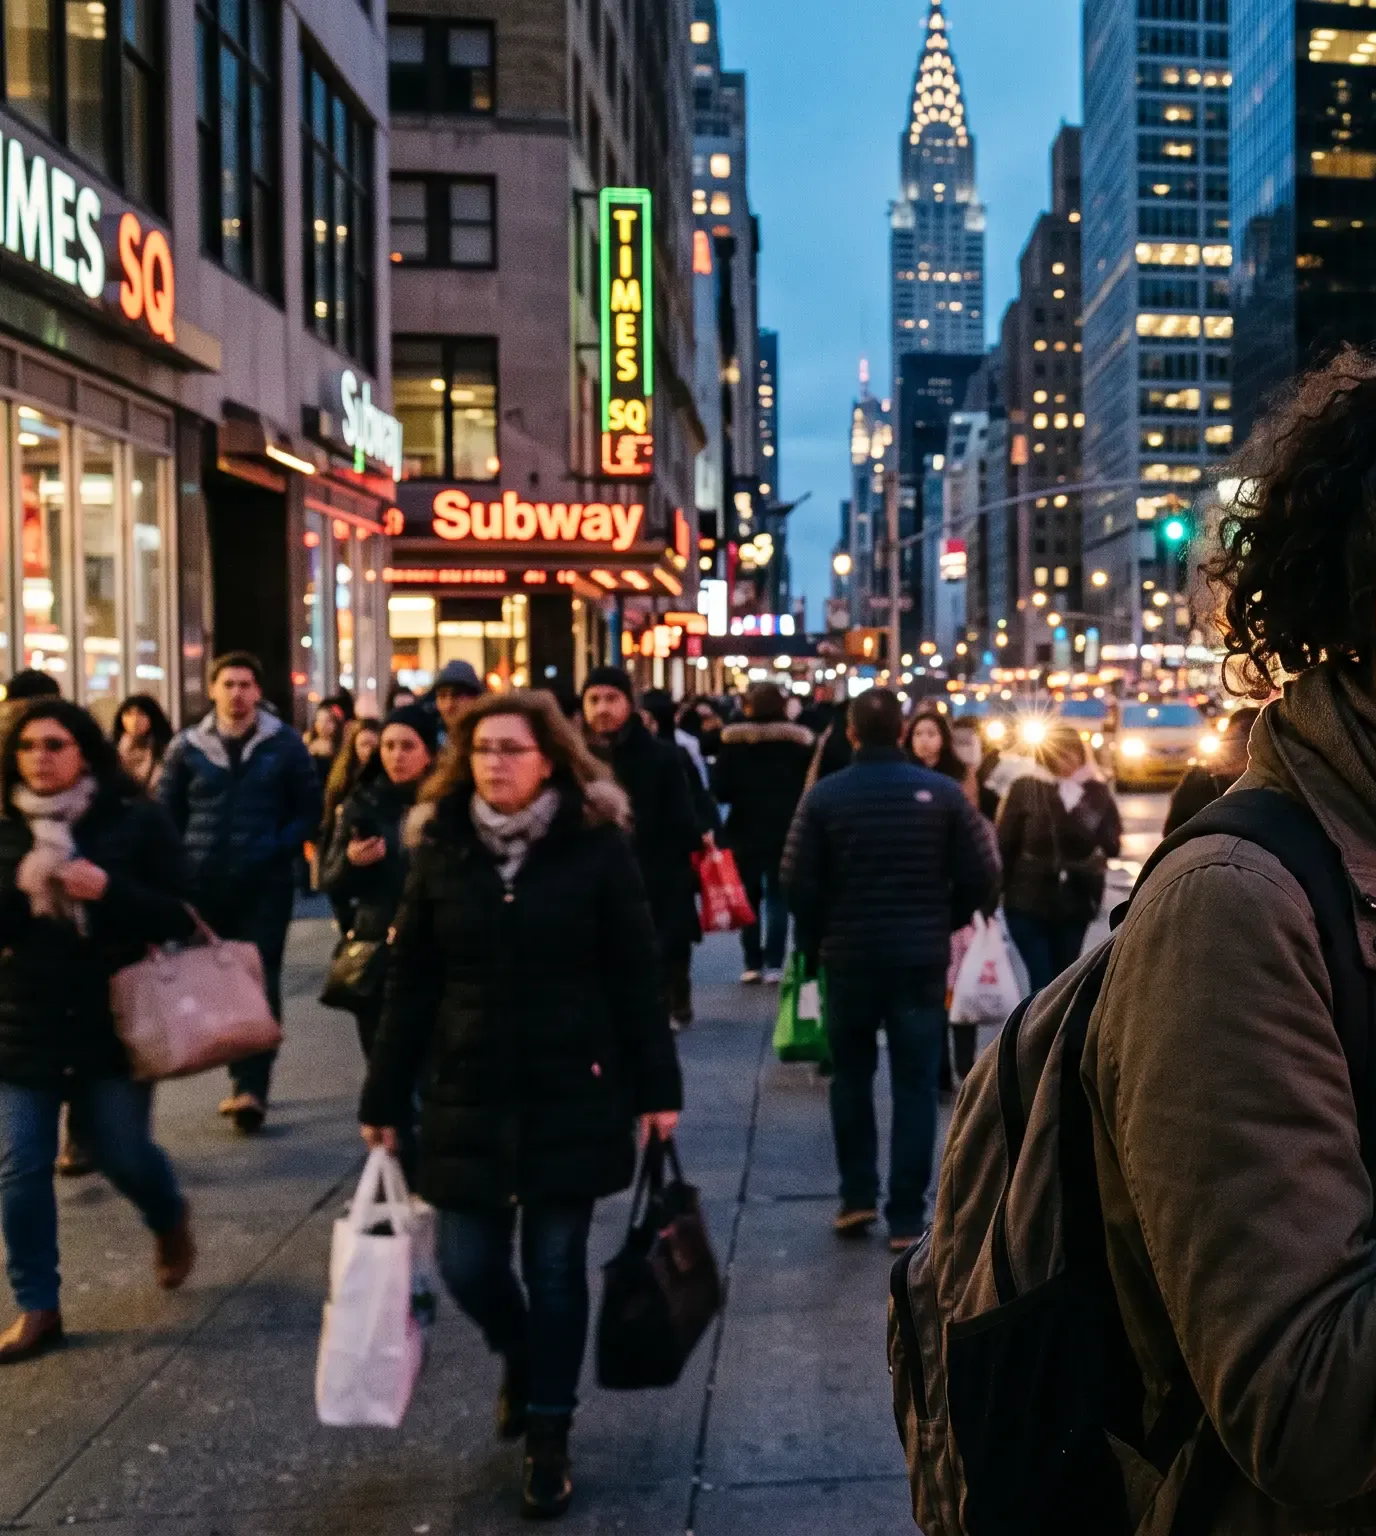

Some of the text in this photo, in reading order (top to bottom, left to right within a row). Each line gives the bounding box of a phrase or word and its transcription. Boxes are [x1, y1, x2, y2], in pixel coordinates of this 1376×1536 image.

[118, 212, 176, 344] SQ
[610, 209, 642, 382] TIMES
[607, 399, 647, 434] SQ
[432, 489, 644, 551] Subway
